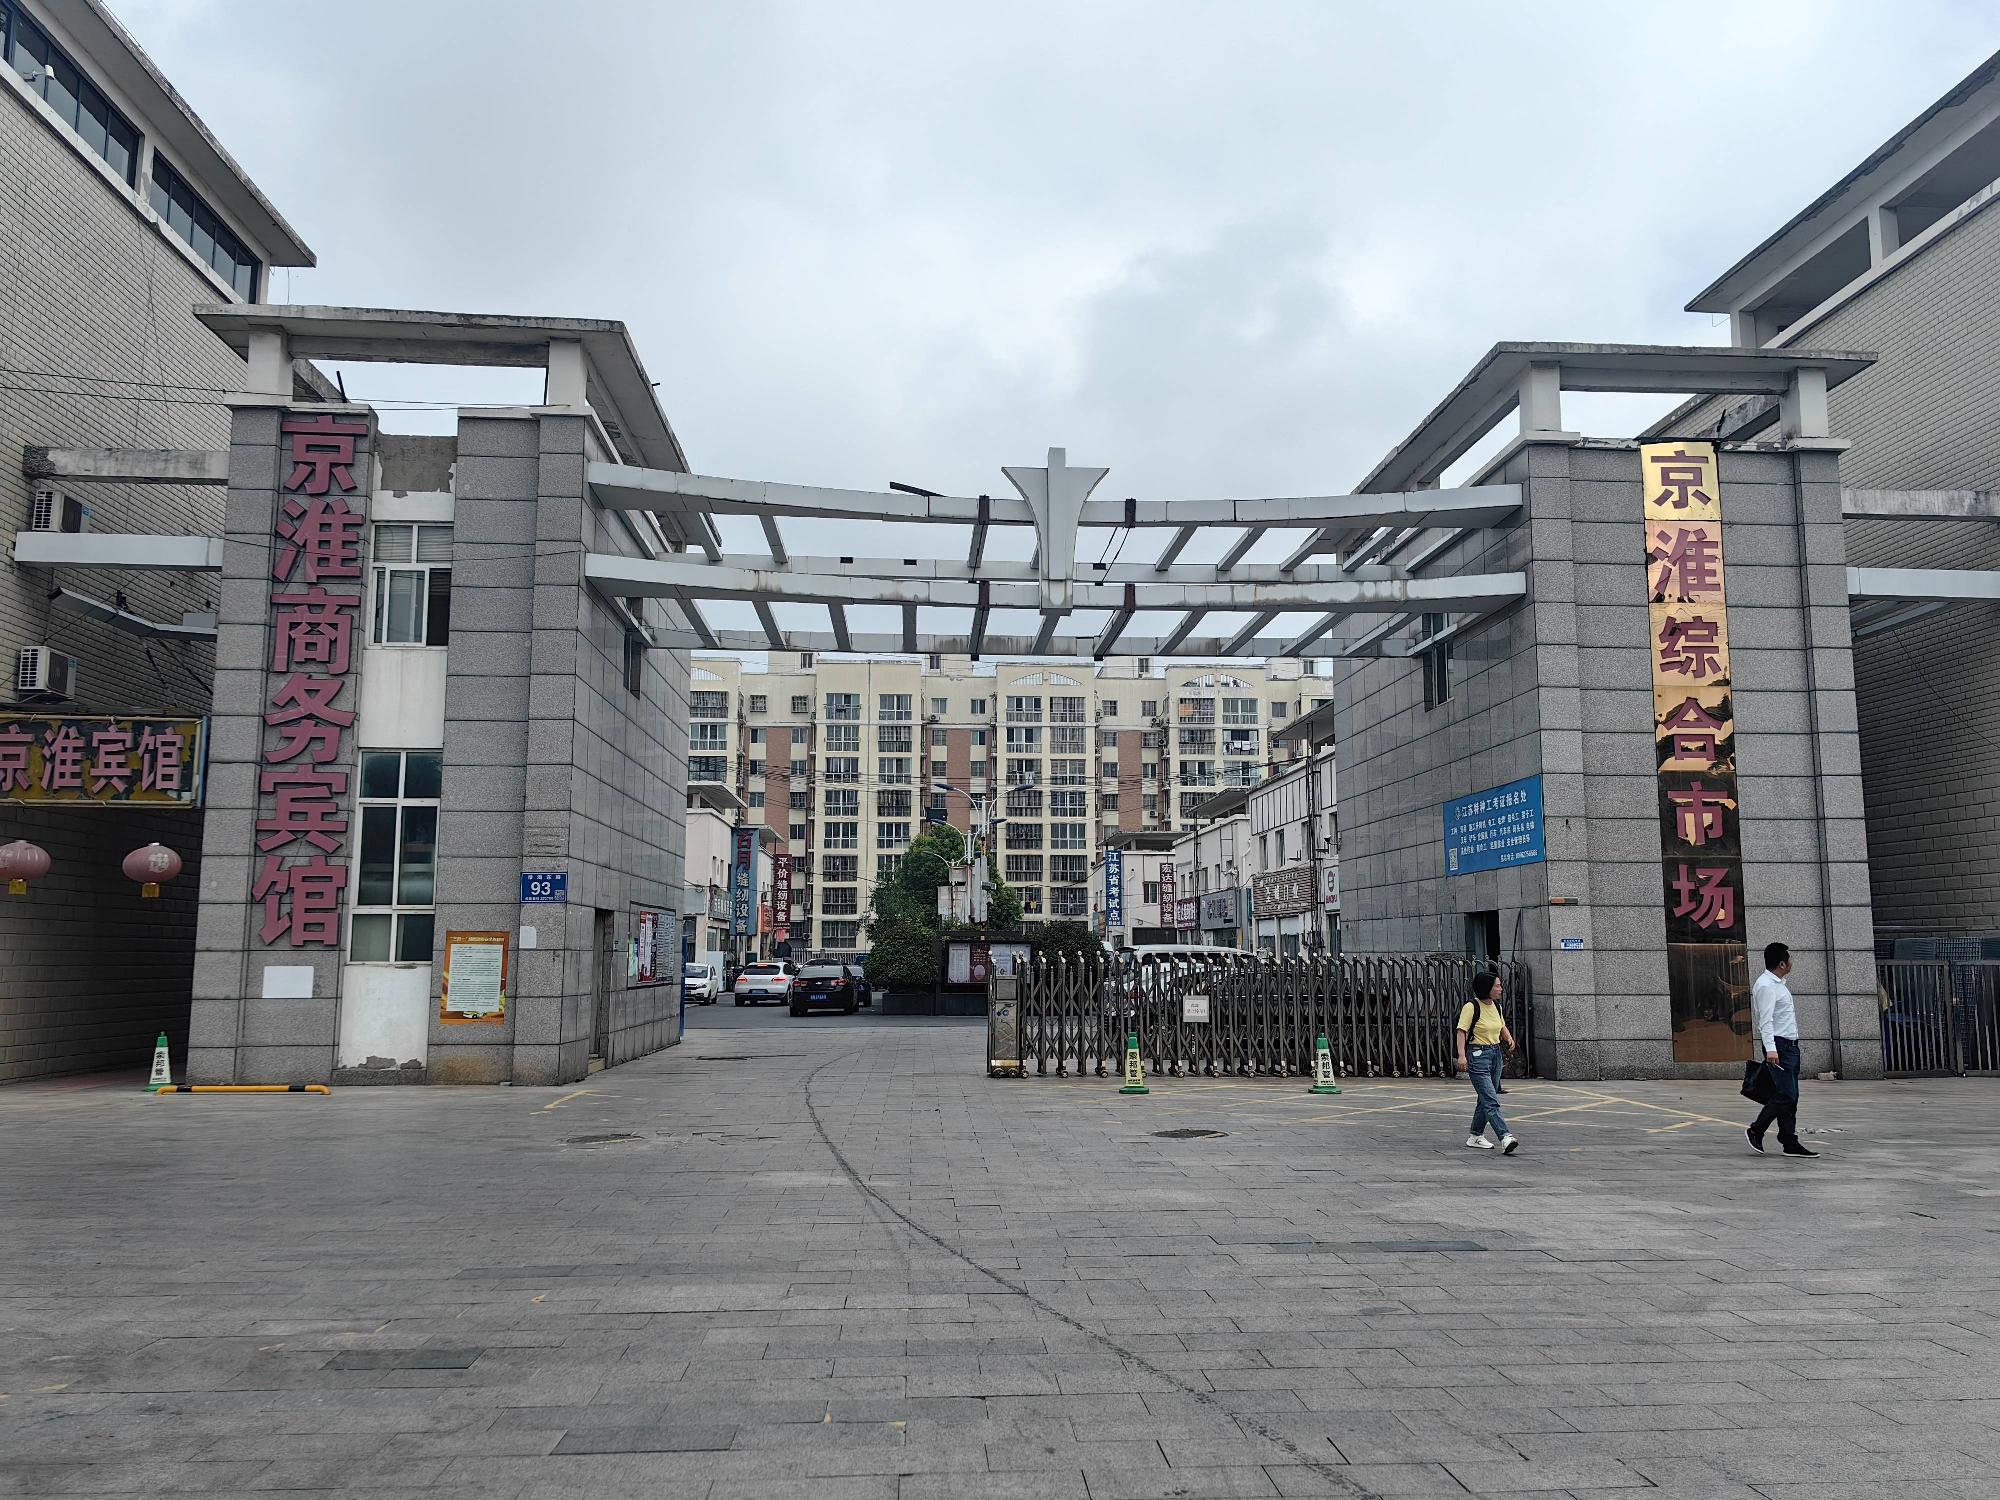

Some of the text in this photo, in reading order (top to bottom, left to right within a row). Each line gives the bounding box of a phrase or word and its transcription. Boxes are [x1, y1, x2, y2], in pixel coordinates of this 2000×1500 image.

[253, 416, 368, 946] 京淮商务宾馆
[1649, 450, 1735, 929] 京淮综合市场
[0, 724, 183, 794] 京淮宾馆
[530, 881, 551, 896] 93
[736, 831, 753, 933] 古月缝纫设备
[776, 857, 789, 922] 平价缝纫设备
[1108, 852, 1120, 921] 江苏省考试点
[1161, 863, 1174, 923] 宏达缝纫设备
